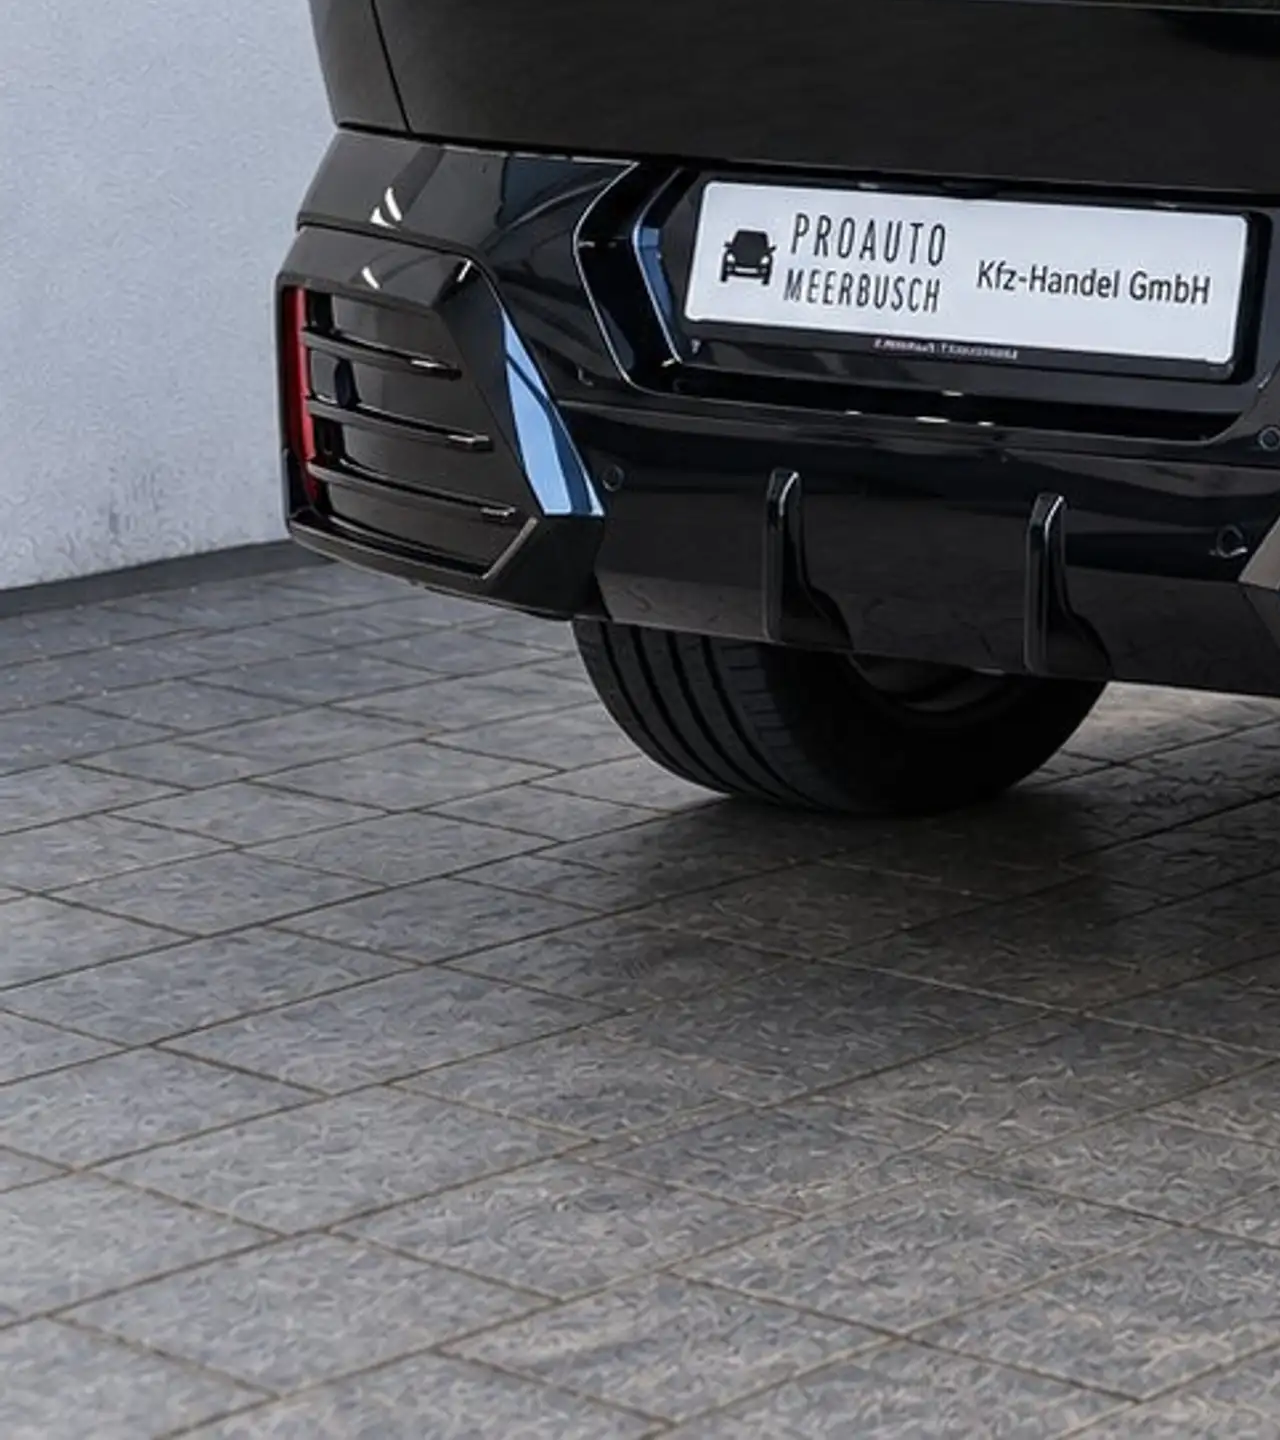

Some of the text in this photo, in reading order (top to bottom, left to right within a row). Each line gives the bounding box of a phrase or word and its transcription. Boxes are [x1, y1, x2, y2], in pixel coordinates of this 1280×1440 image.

[790, 212, 946, 266] PROAUTO
[784, 268, 941, 313] MEERBUSCH
[977, 260, 1211, 304] Kfz-Handel GmbH
